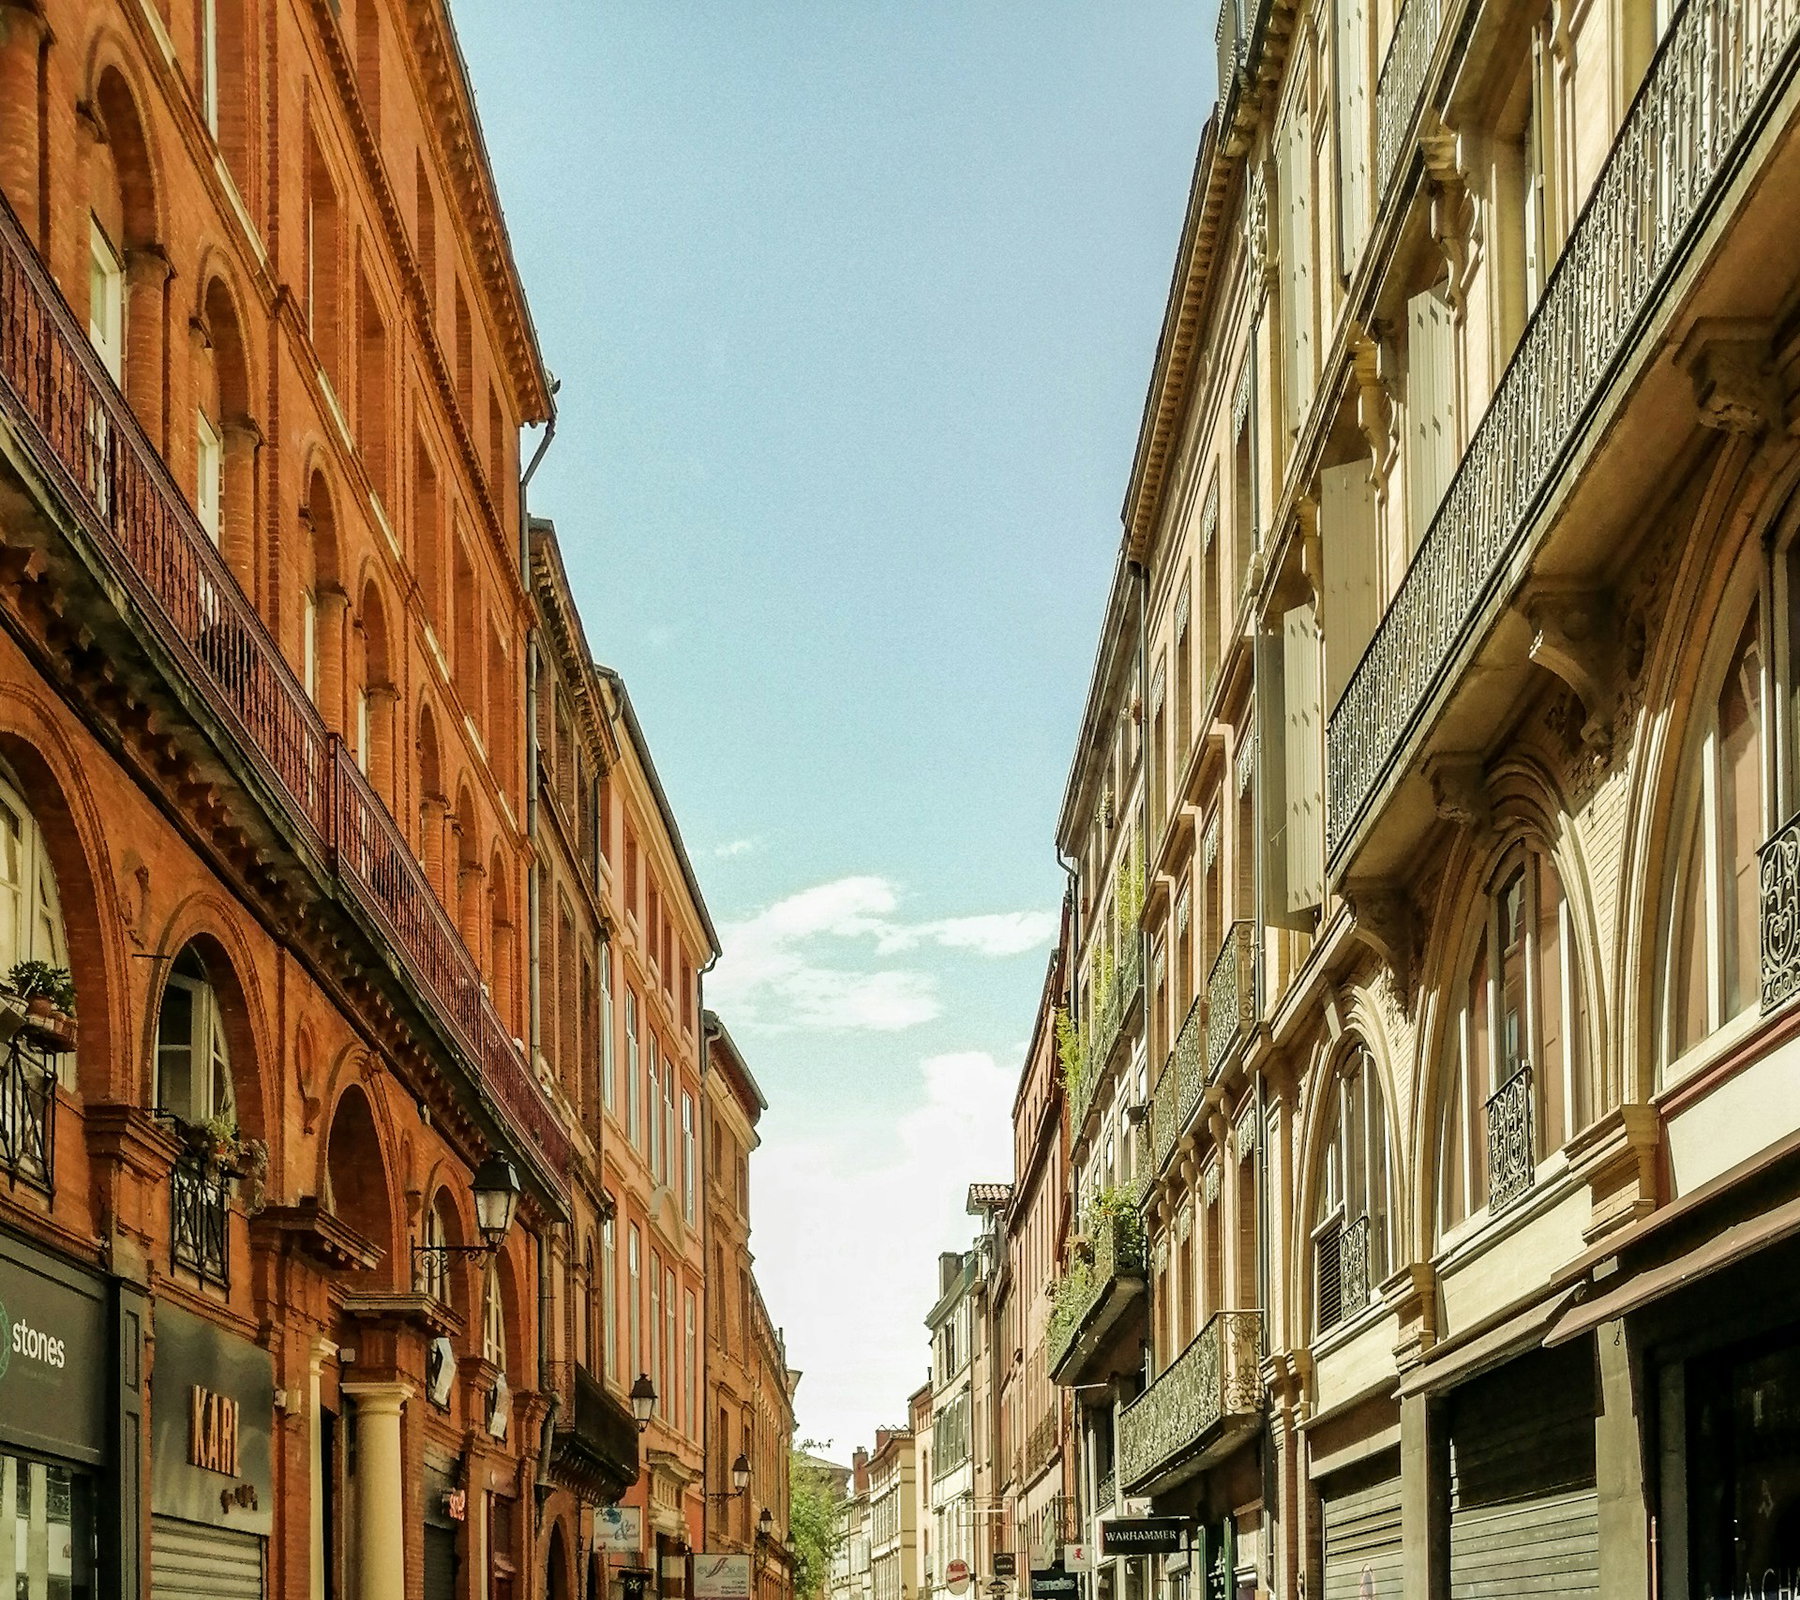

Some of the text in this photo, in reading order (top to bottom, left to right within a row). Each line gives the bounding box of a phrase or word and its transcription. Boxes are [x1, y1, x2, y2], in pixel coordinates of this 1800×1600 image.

[12, 1318, 65, 1369] stones
[193, 1384, 241, 1478] KARL
[1105, 1529, 1177, 1541] WARHAMMER
